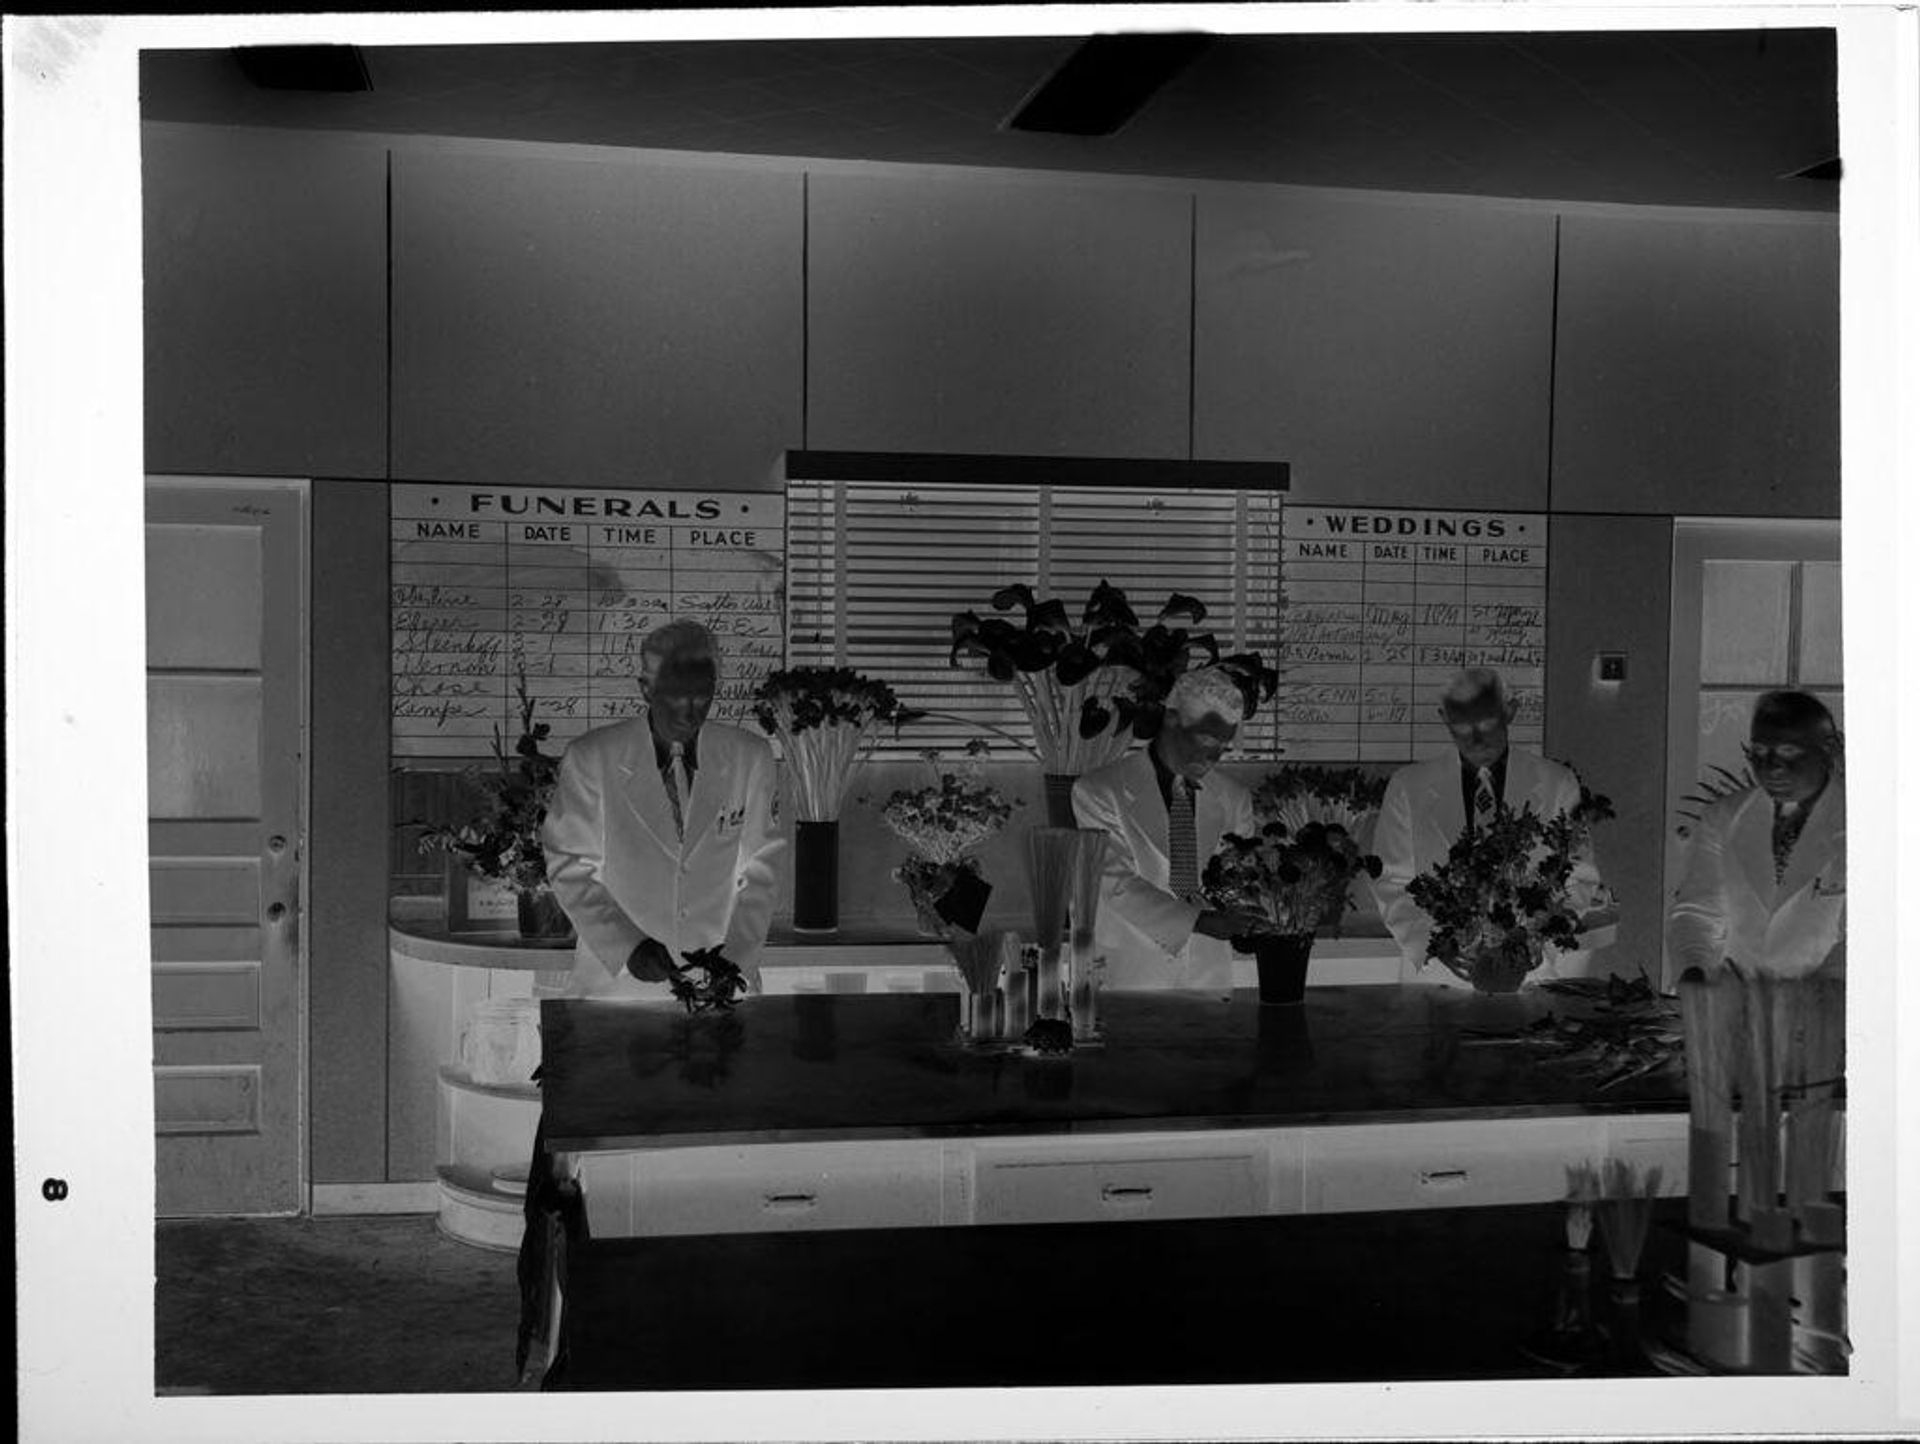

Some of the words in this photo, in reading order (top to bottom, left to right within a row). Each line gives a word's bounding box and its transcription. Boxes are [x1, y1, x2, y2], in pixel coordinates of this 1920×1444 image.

[470, 494, 721, 520] FUNERALS
[417, 523, 481, 539] NAME
[524, 526, 572, 541] DATE
[603, 528, 657, 544] TIME
[690, 531, 756, 547] PLACE
[1325, 515, 1506, 538] WEDDINGS
[1299, 543, 1349, 558] NAME
[1374, 546, 1407, 559] DATE
[1424, 547, 1458, 561] TIME
[1483, 549, 1530, 563] PLACE
[42, 1177, 69, 1202] 8
